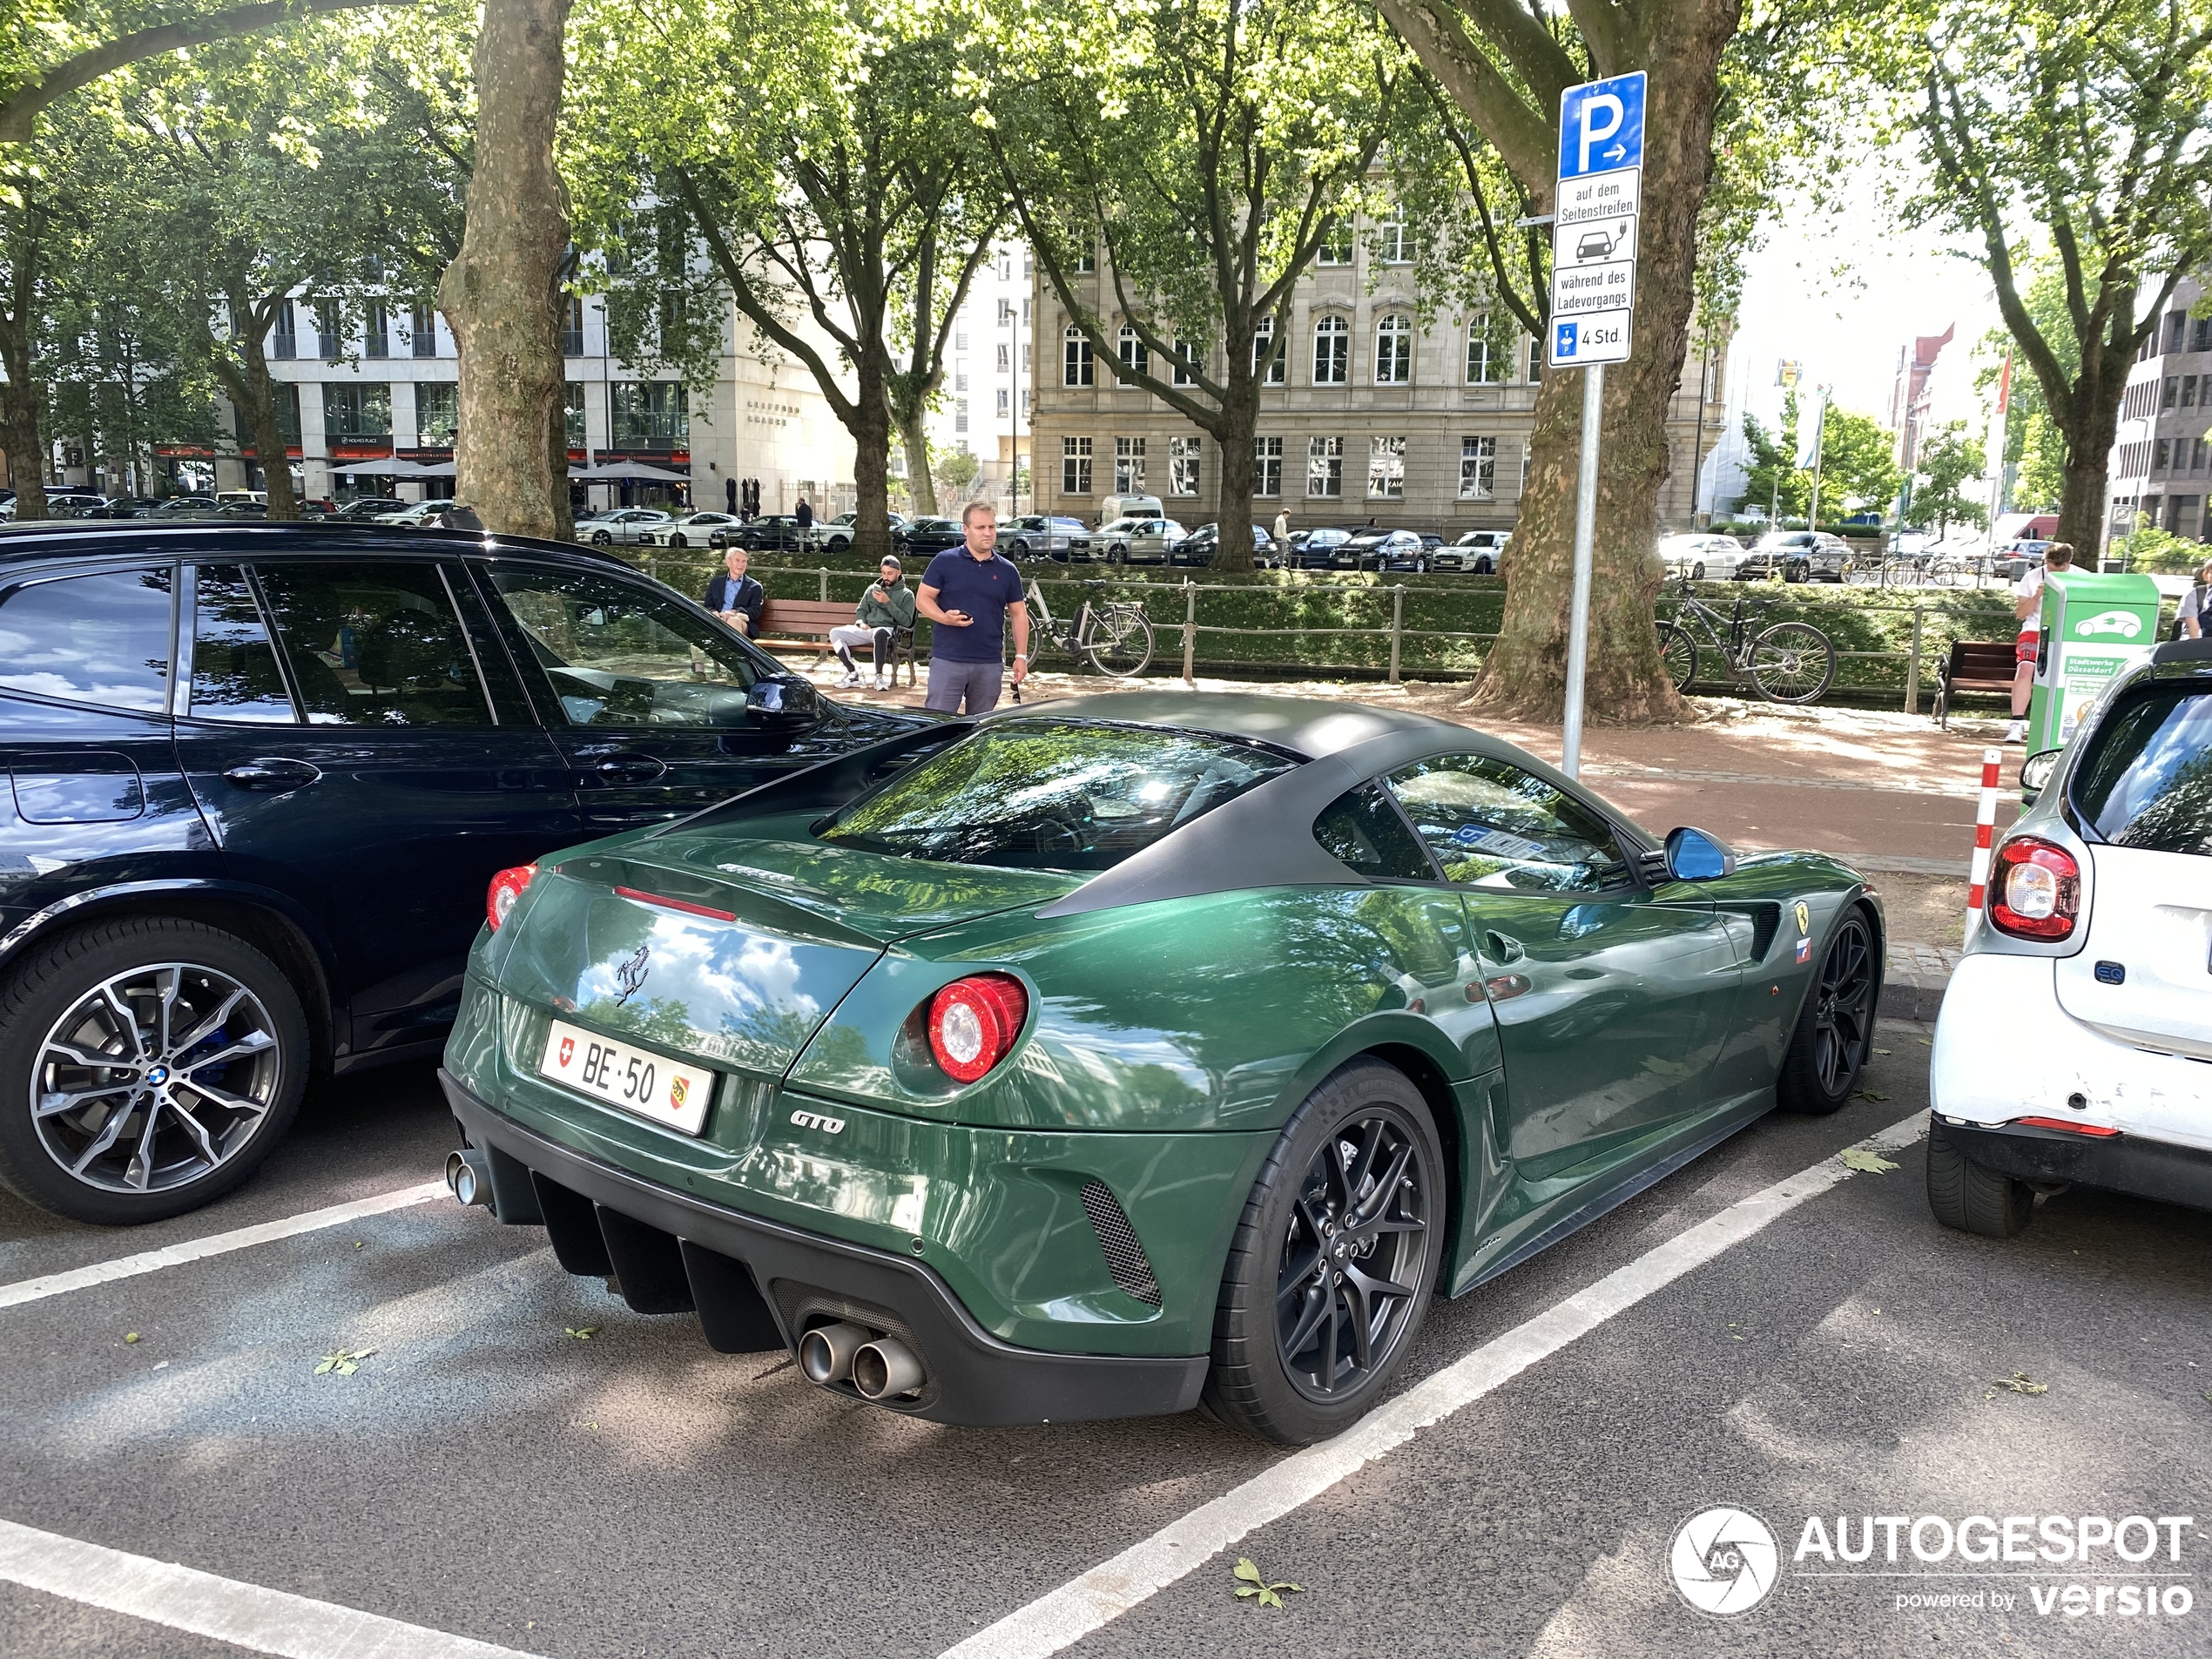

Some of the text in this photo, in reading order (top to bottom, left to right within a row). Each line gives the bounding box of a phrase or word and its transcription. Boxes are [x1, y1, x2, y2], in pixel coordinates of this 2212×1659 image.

[1578, 93, 1624, 172] P
[1576, 183, 1620, 201] auf dem
[1561, 199, 1633, 222] Seitenstreifen
[1561, 270, 1626, 290] während des
[1557, 292, 1627, 310] Ladevorgangs
[1581, 327, 1622, 346] 4 Std.
[746, 400, 800, 414] CLIFFORD
[746, 415, 787, 427] CHANCE
[2067, 665, 2114, 674] Düsseldorf
[2068, 658, 2114, 666] Stadtwerke
[2096, 966, 2123, 980] EQ
[790, 1109, 846, 1135] GTO
